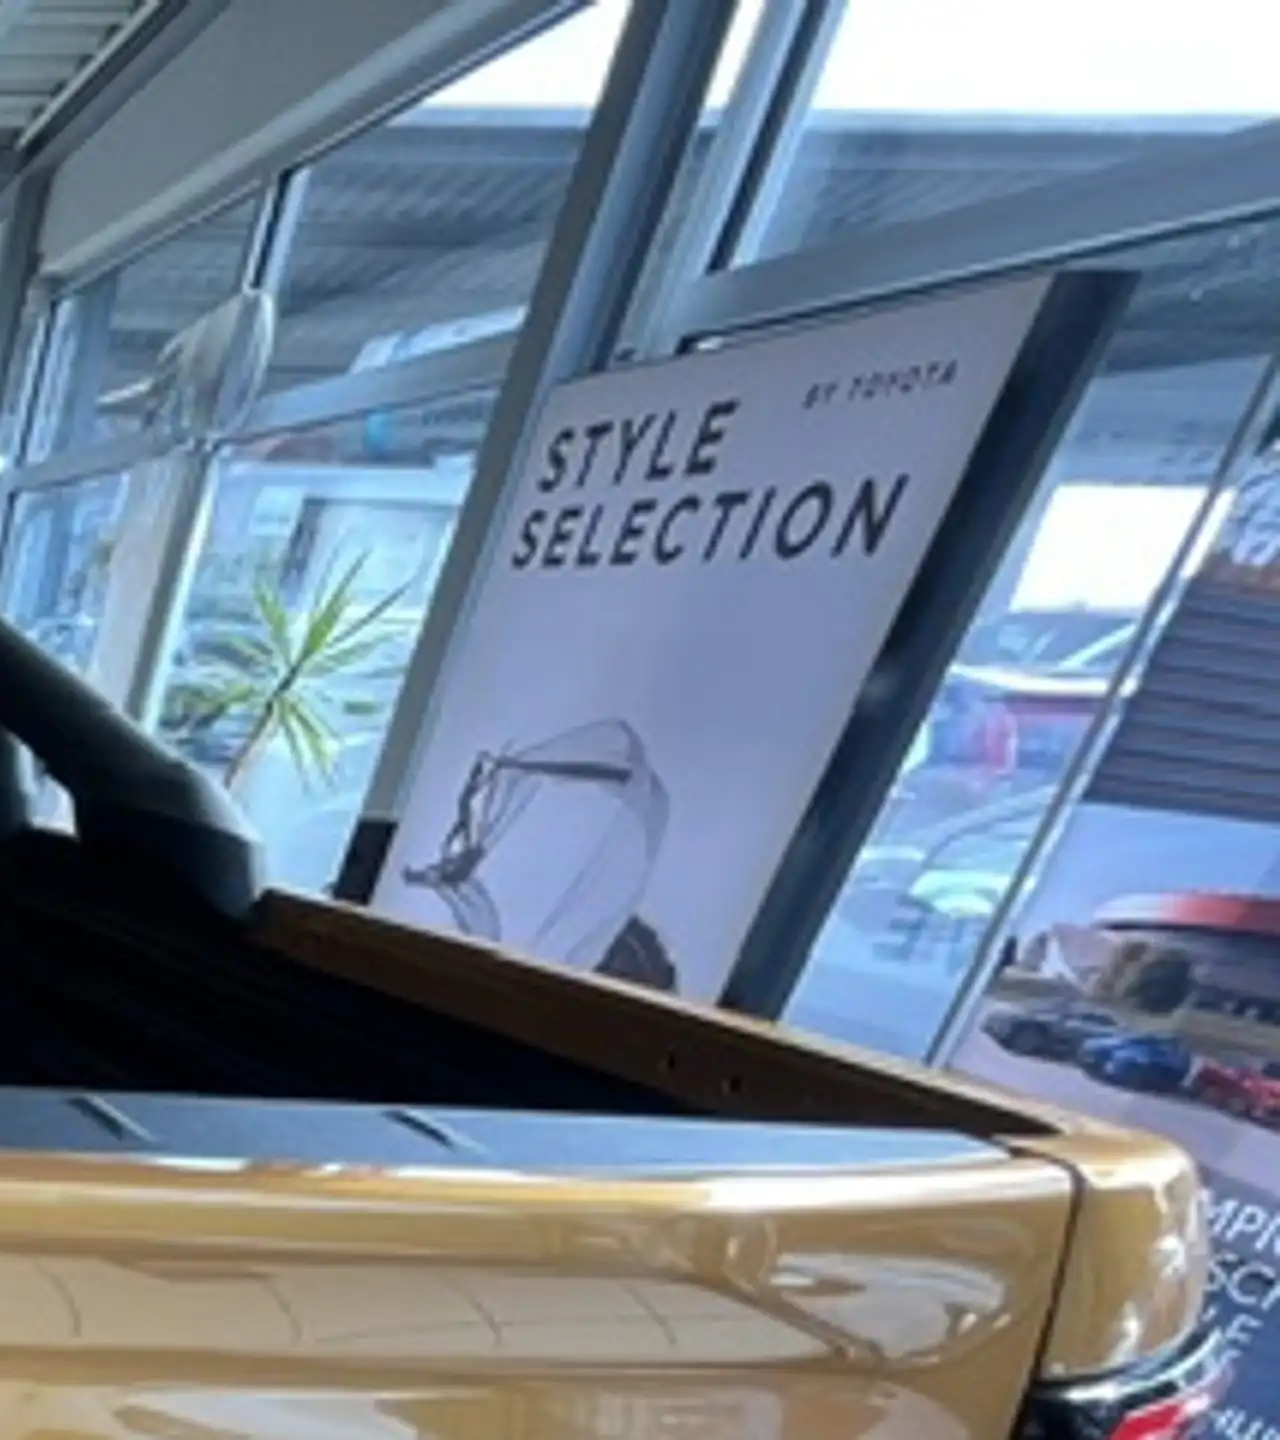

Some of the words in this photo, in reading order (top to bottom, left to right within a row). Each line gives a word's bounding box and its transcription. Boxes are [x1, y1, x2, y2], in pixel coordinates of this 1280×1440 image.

[846, 359, 958, 403] TOYOTA
[537, 397, 740, 493] STYLE
[510, 473, 911, 570] SELECTION
